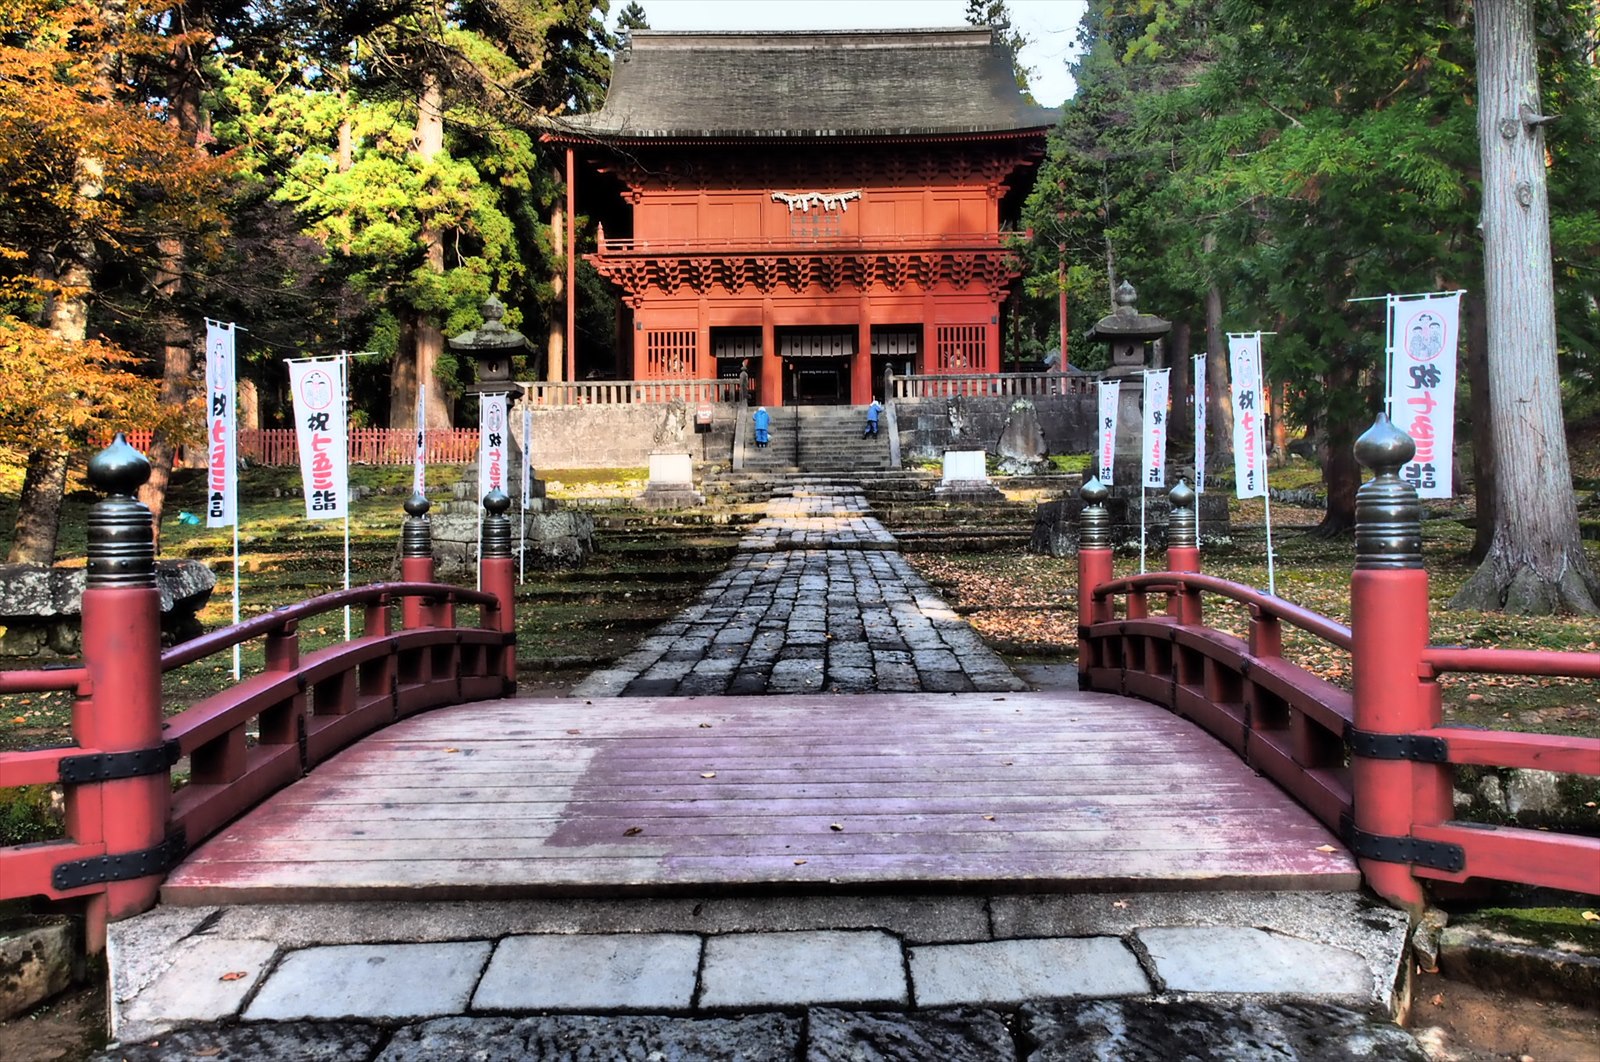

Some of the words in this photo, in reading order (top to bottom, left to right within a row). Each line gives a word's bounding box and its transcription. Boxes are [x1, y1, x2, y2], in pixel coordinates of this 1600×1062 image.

[307, 412, 336, 511] 祝七五三詣
